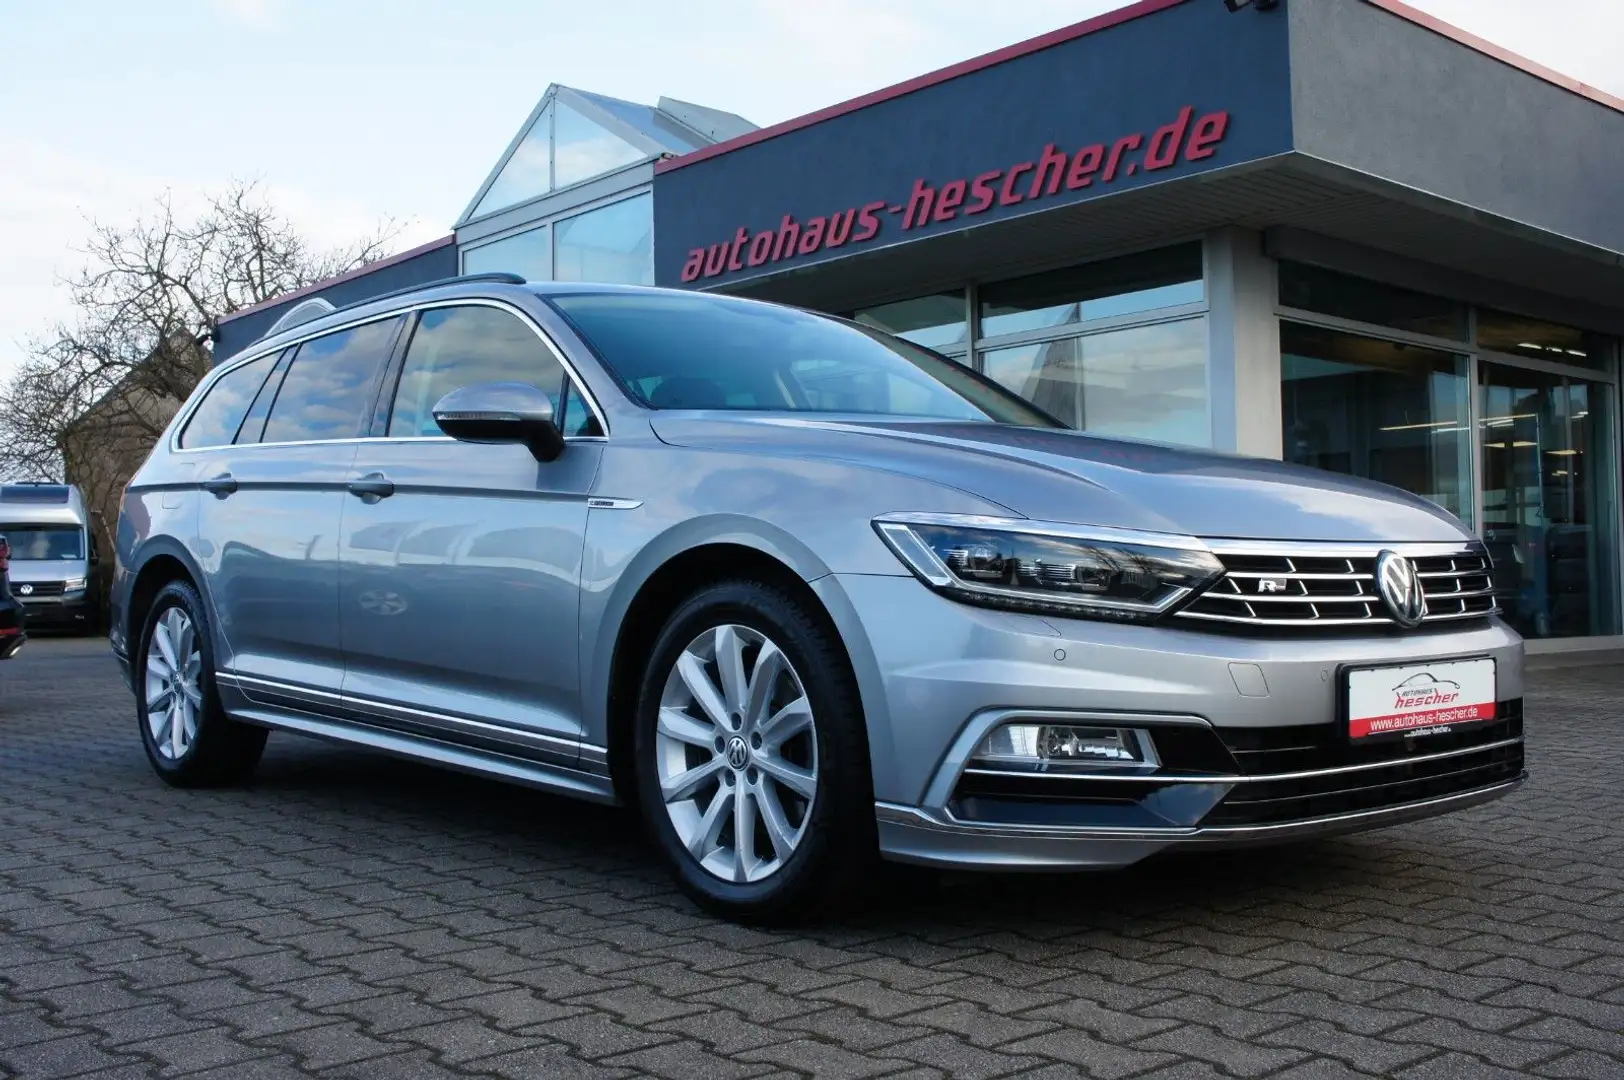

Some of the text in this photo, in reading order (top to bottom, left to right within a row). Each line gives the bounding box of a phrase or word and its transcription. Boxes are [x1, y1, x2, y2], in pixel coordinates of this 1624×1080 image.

[681, 105, 1229, 282] autohaus-hescher.de
[1394, 687, 1460, 709] hescher
[1370, 706, 1478, 731] www.autohaus-hescher.de
